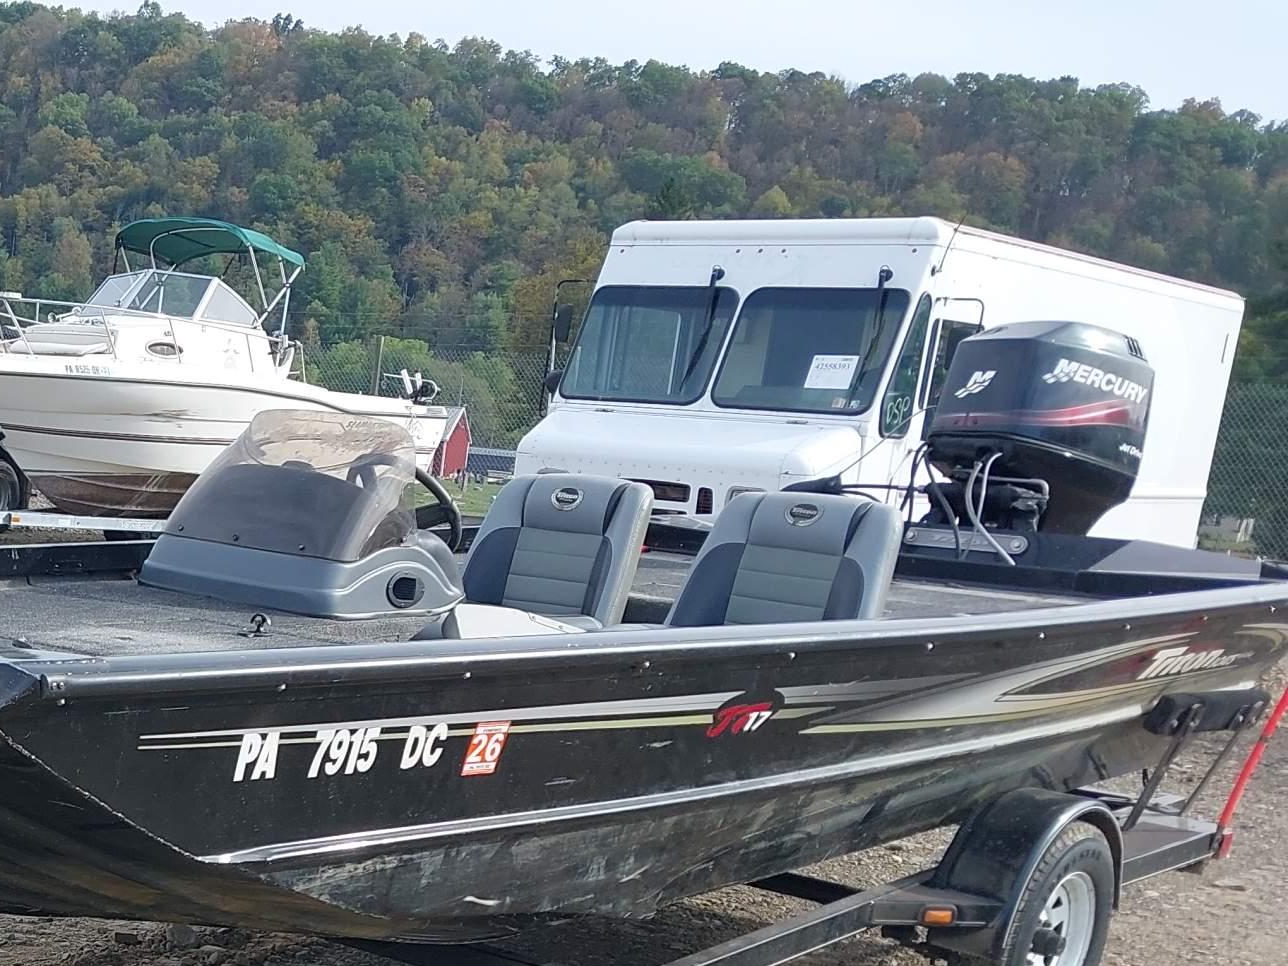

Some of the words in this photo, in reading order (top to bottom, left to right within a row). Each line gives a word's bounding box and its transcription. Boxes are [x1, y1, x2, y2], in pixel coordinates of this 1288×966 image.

[1043, 358, 1147, 404] MERCURY
[233, 732, 280, 782] PA
[307, 727, 382, 778] 7915
[400, 722, 449, 770] DC
[466, 733, 505, 763] 26
